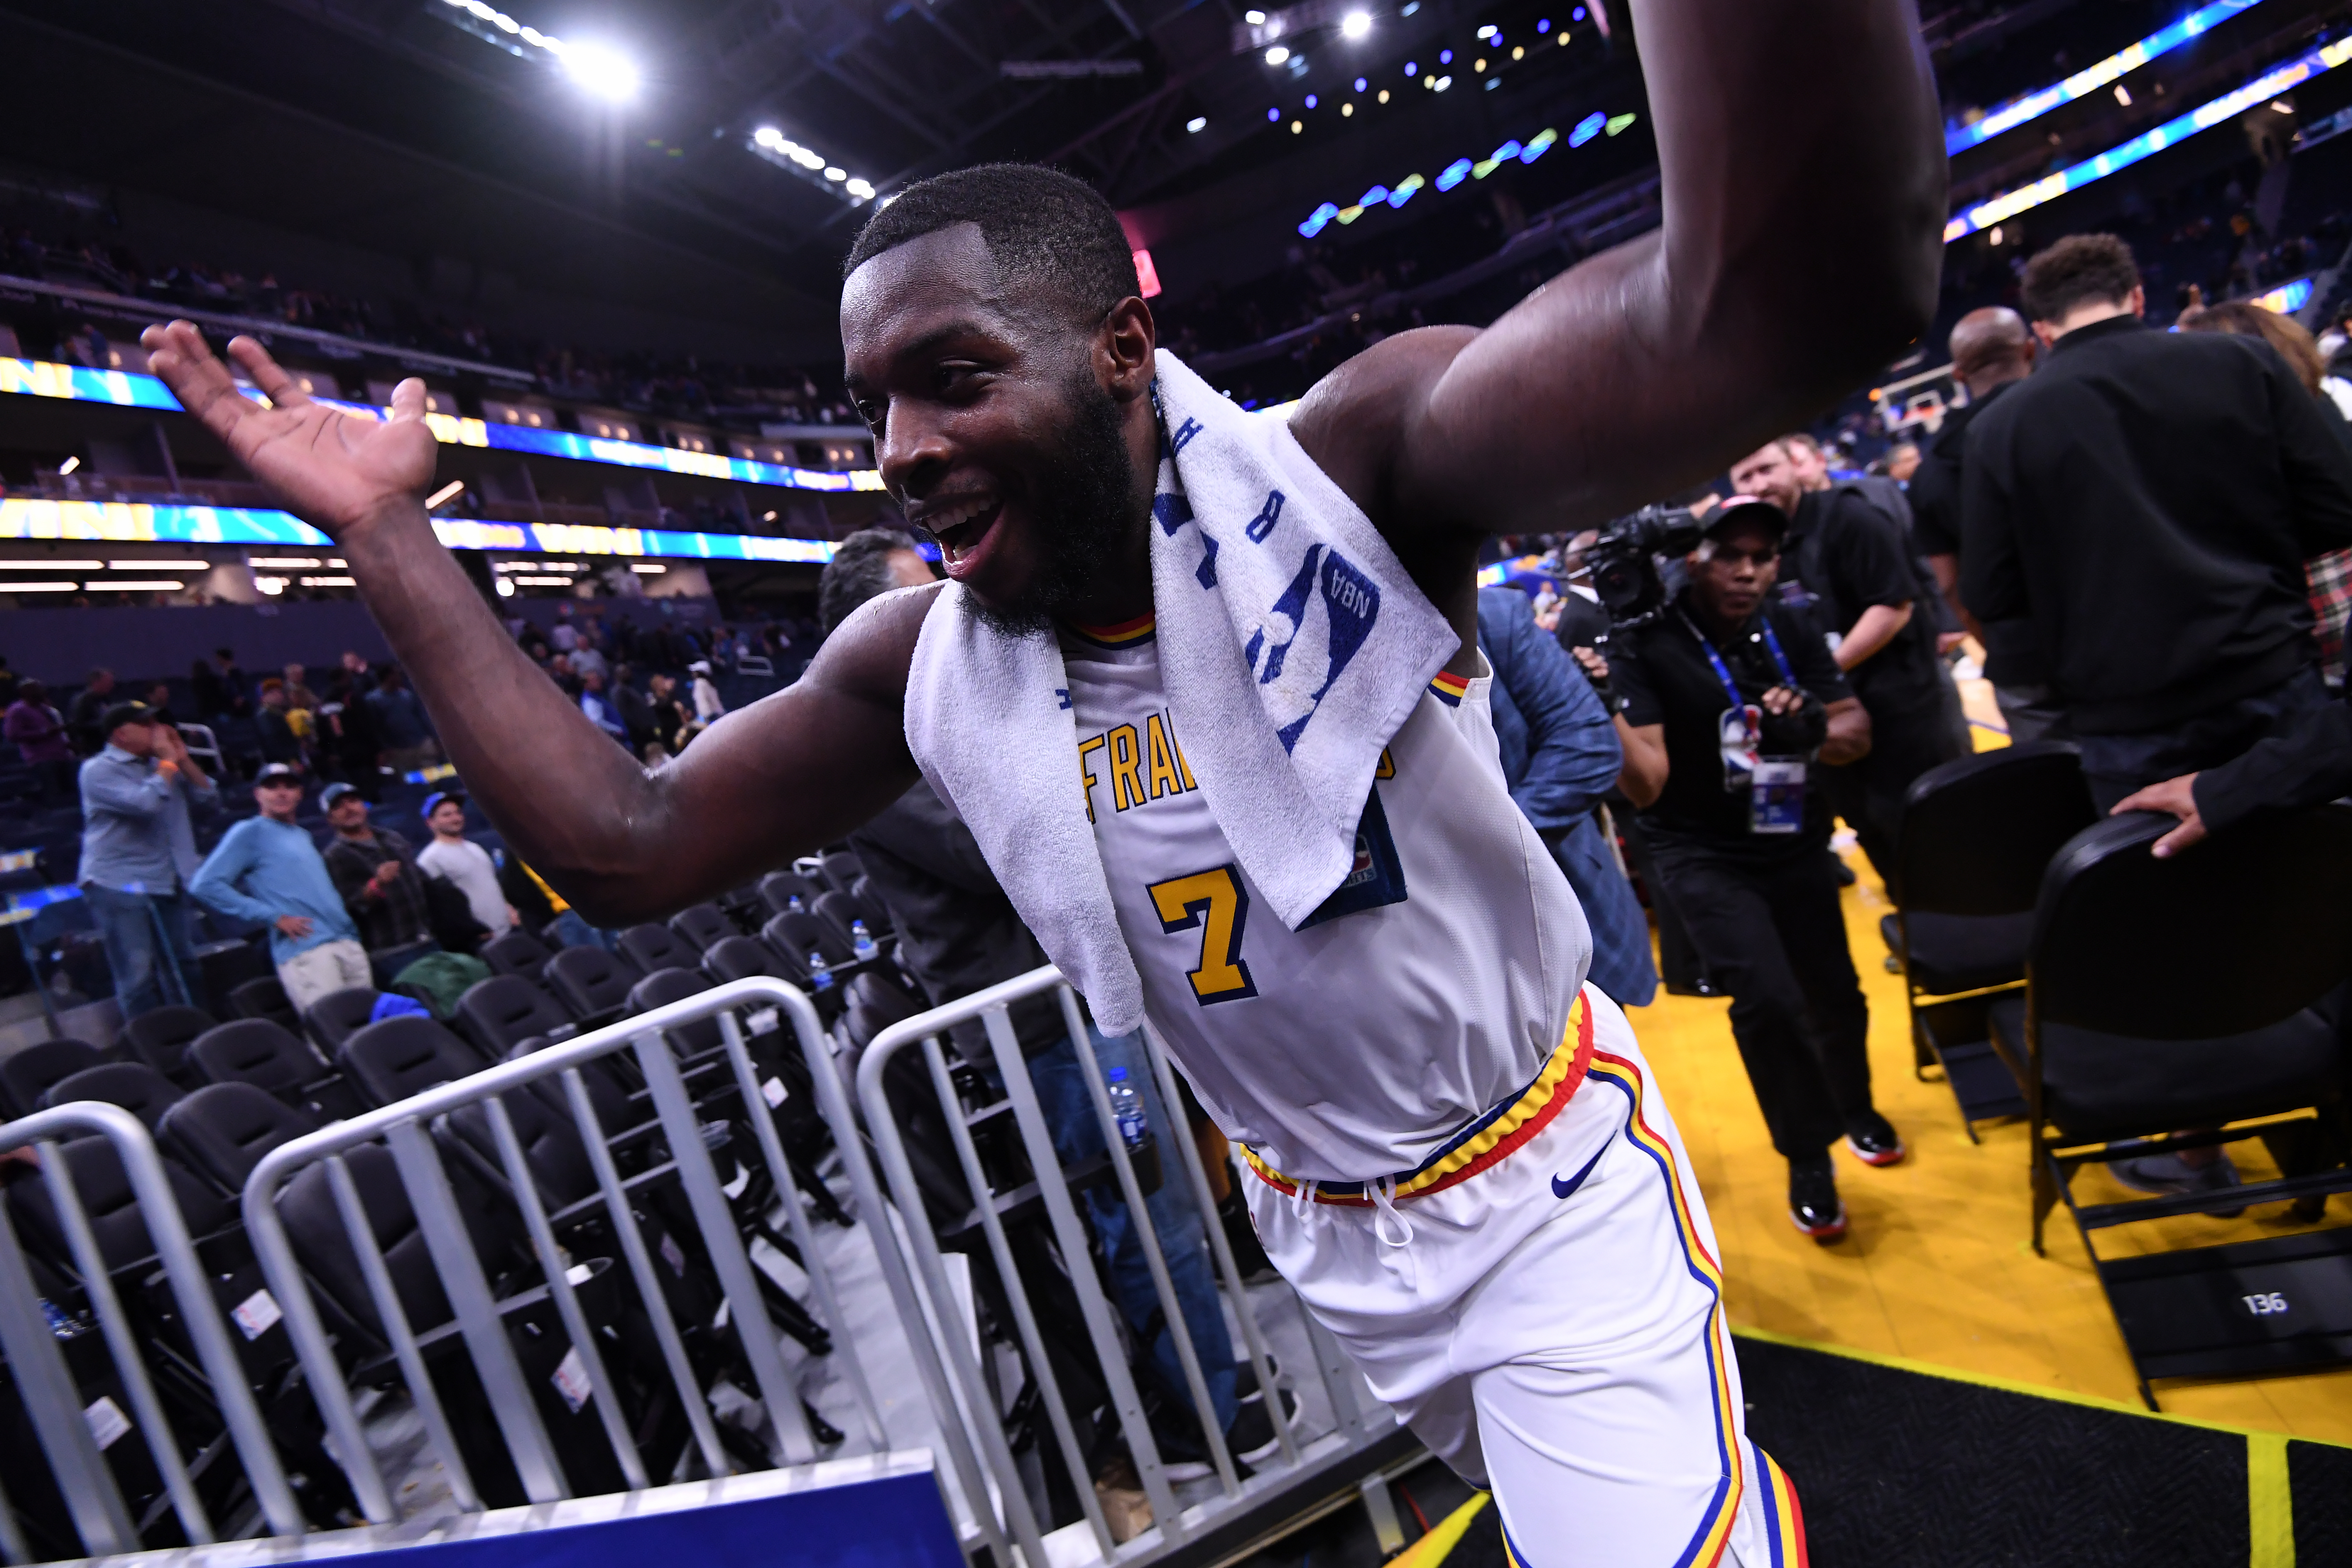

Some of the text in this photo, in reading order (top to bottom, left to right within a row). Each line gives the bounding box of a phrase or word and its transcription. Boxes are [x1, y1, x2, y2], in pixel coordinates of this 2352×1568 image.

[1331, 569, 1370, 618] NBA
[1145, 863, 1259, 1007] 7
[2241, 1292, 2289, 1315] 136
